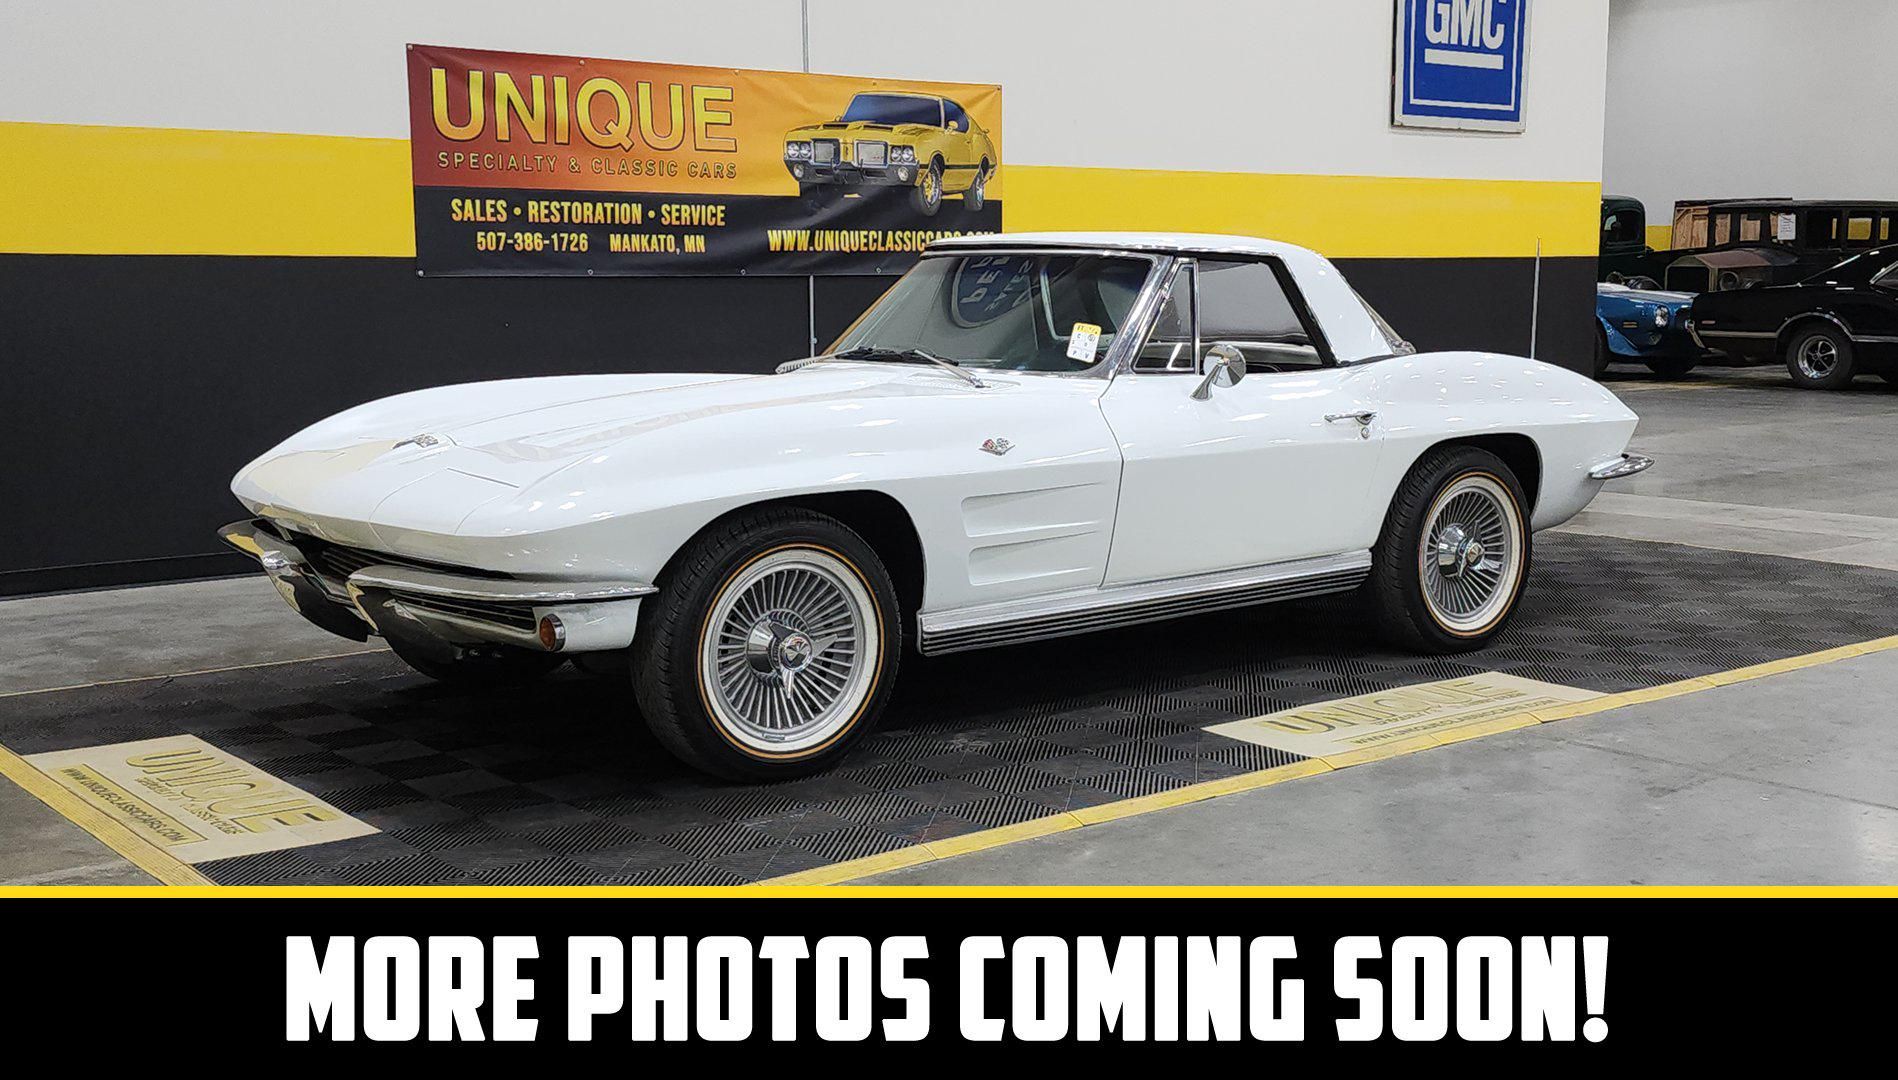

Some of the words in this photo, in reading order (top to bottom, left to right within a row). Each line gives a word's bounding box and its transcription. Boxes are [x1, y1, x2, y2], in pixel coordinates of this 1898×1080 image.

[1425, 0, 1505, 49] GMC
[431, 67, 737, 152] UNIQUE
[438, 151, 556, 172] SPECIALTY
[568, 156, 581, 173] &
[591, 158, 678, 176] CLASSIC
[687, 161, 737, 179] CARS
[451, 198, 507, 222] SALES
[528, 200, 642, 224] RESTORATION
[660, 204, 726, 226] SERVICE
[477, 231, 588, 252] 507-386-1726
[609, 233, 681, 255] MANKATO,
[684, 234, 706, 253] MN
[1262, 680, 1521, 735] UNIQUE
[126, 747, 344, 834] UNIQUE
